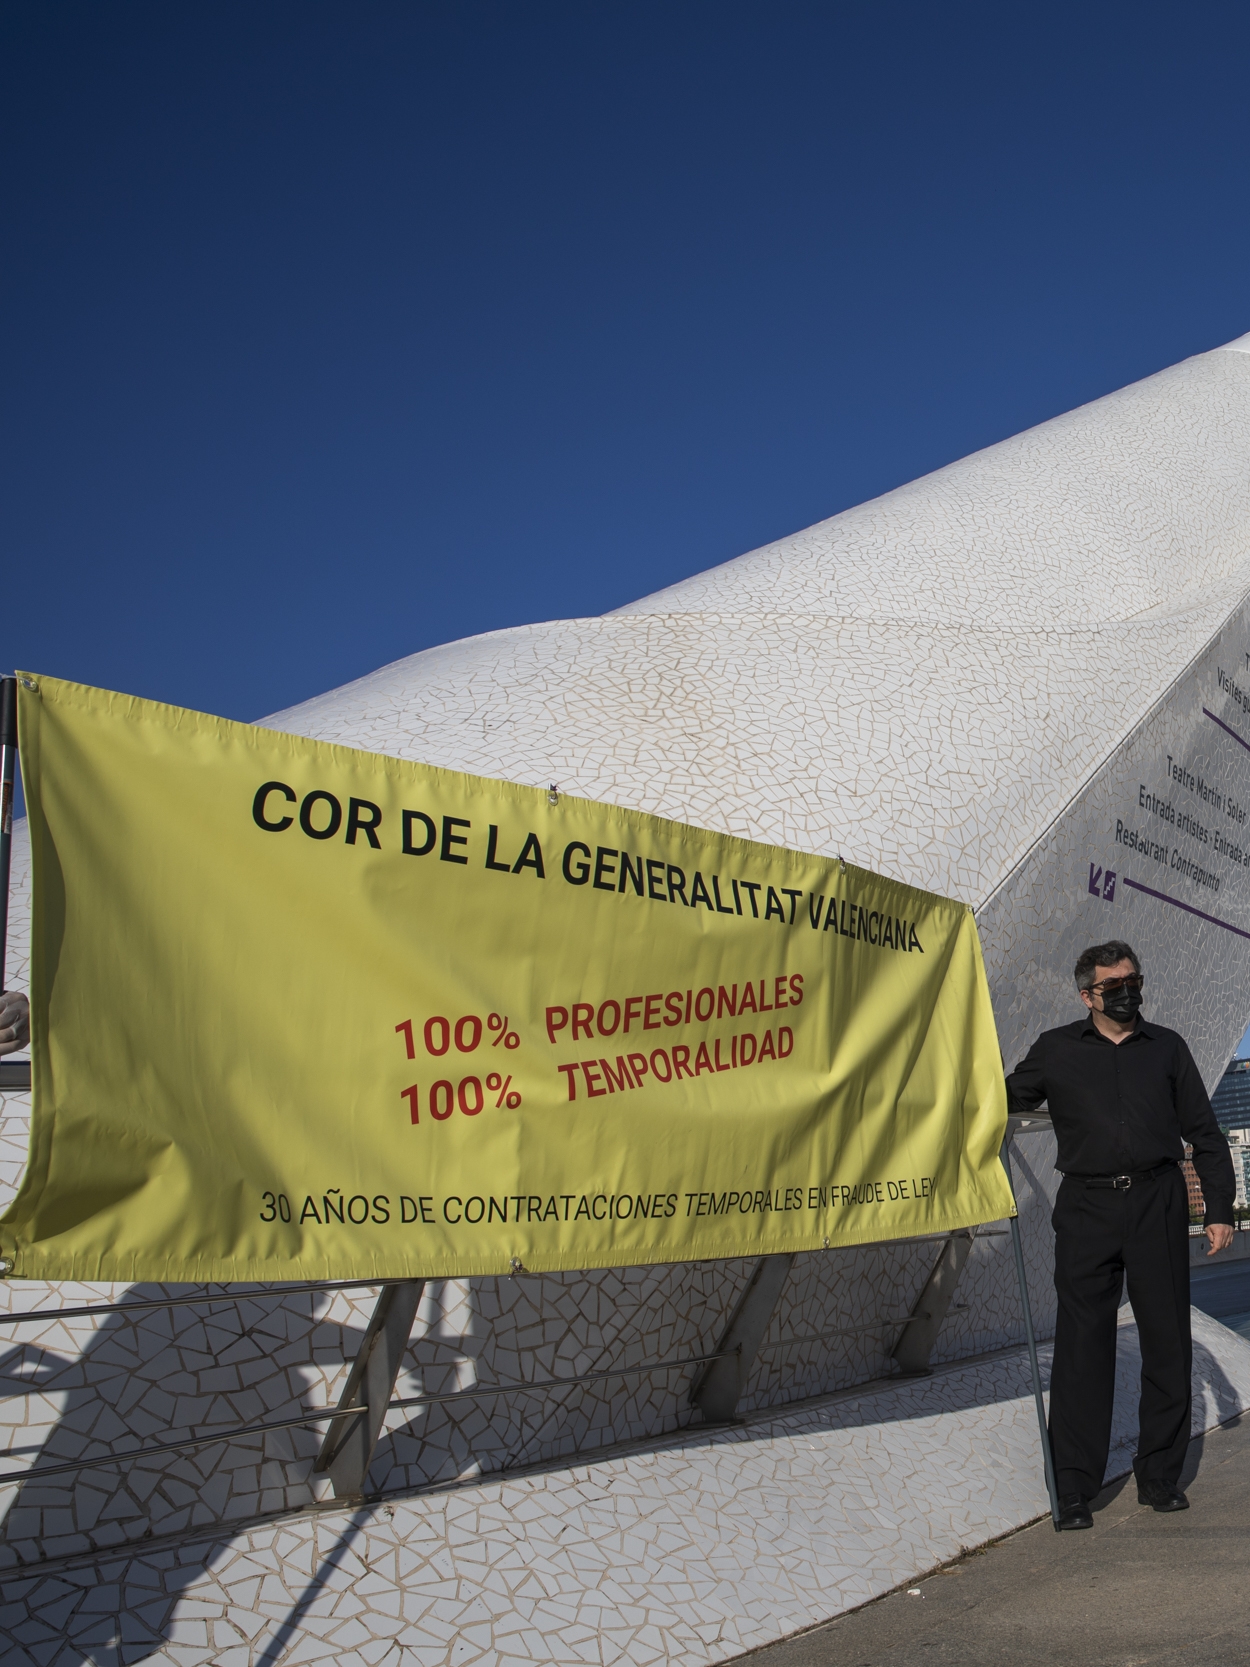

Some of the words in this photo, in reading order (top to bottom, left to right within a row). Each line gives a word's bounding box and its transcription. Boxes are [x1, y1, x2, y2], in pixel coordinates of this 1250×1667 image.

[1217, 666, 1242, 704] Visites
[1139, 784, 1175, 824] Entrada
[1177, 811, 1208, 844] artistes
[1214, 830, 1242, 864] Entrada
[1167, 755, 1195, 792] Teatre
[1222, 796, 1227, 813] i
[1227, 797, 1246, 825] Soler
[252, 781, 382, 850] COR
[402, 809, 471, 865] DE
[485, 824, 546, 879] LA
[562, 841, 803, 925] GENERALITAT
[809, 892, 925, 953] VALENCIANA
[1115, 818, 1168, 865] Restaurant
[1170, 849, 1220, 892] Contrapunto
[395, 1012, 520, 1060] 100%
[545, 974, 804, 1044] PROFESIONALES
[400, 1072, 522, 1125] 100%
[557, 1026, 795, 1102] TEMPORALIDAD
[259, 1191, 292, 1223] 30
[299, 1188, 391, 1225] AÑOS
[400, 1195, 436, 1224] DE
[443, 1193, 679, 1224] CONTRATACIONES
[685, 1188, 803, 1217] TEMPORALES
[807, 1186, 827, 1210] EN
[831, 1182, 885, 1207] FRAUDE
[887, 1180, 910, 1201] DE
[912, 1177, 936, 1199] LEY
